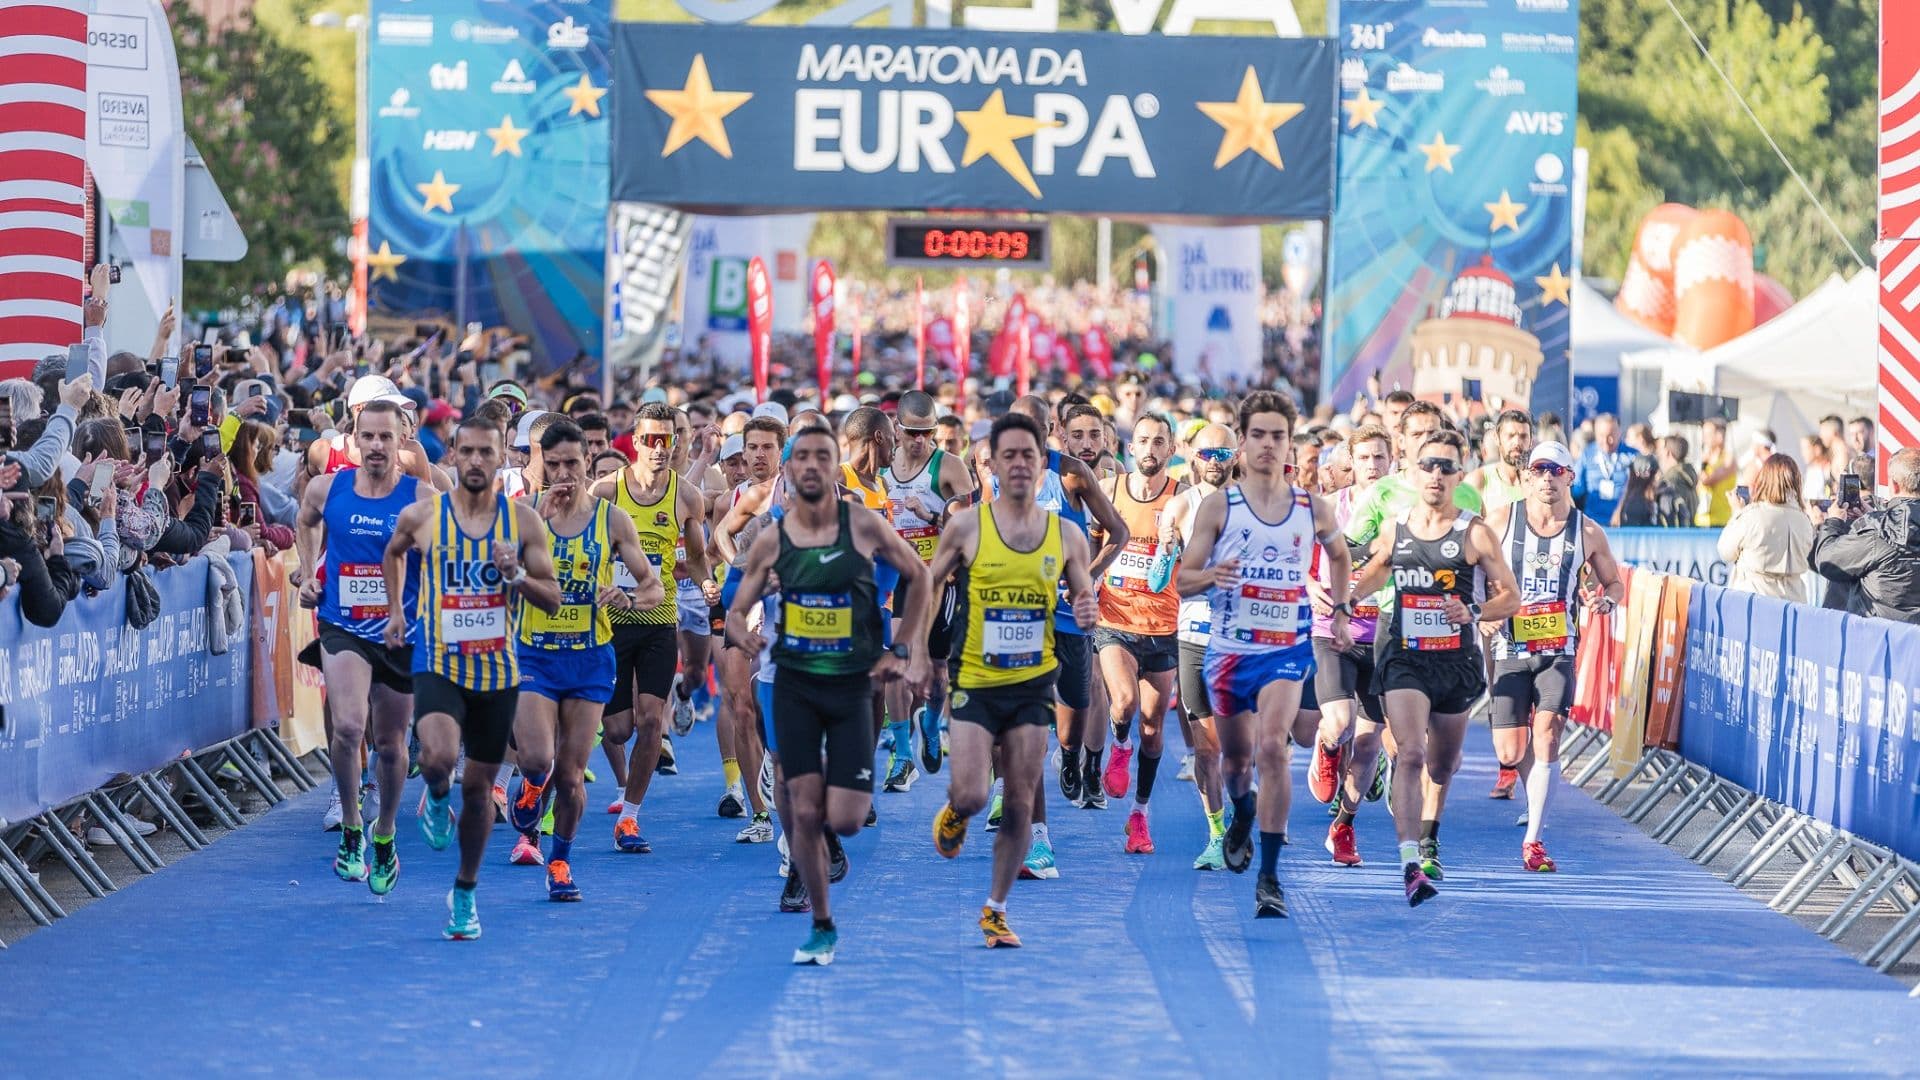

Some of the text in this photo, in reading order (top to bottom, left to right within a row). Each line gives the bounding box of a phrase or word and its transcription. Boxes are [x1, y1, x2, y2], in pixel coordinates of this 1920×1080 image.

[795, 44, 1088, 86] MARATONA DA
[924, 229, 1029, 259] 0:00:09
[445, 559, 503, 590] LKO
[1652, 559, 1728, 586] VIAG
[453, 611, 496, 628] 8645
[1250, 602, 1290, 619] 8408
[997, 626, 1034, 641] 1086
[1523, 616, 1557, 630] 8529
